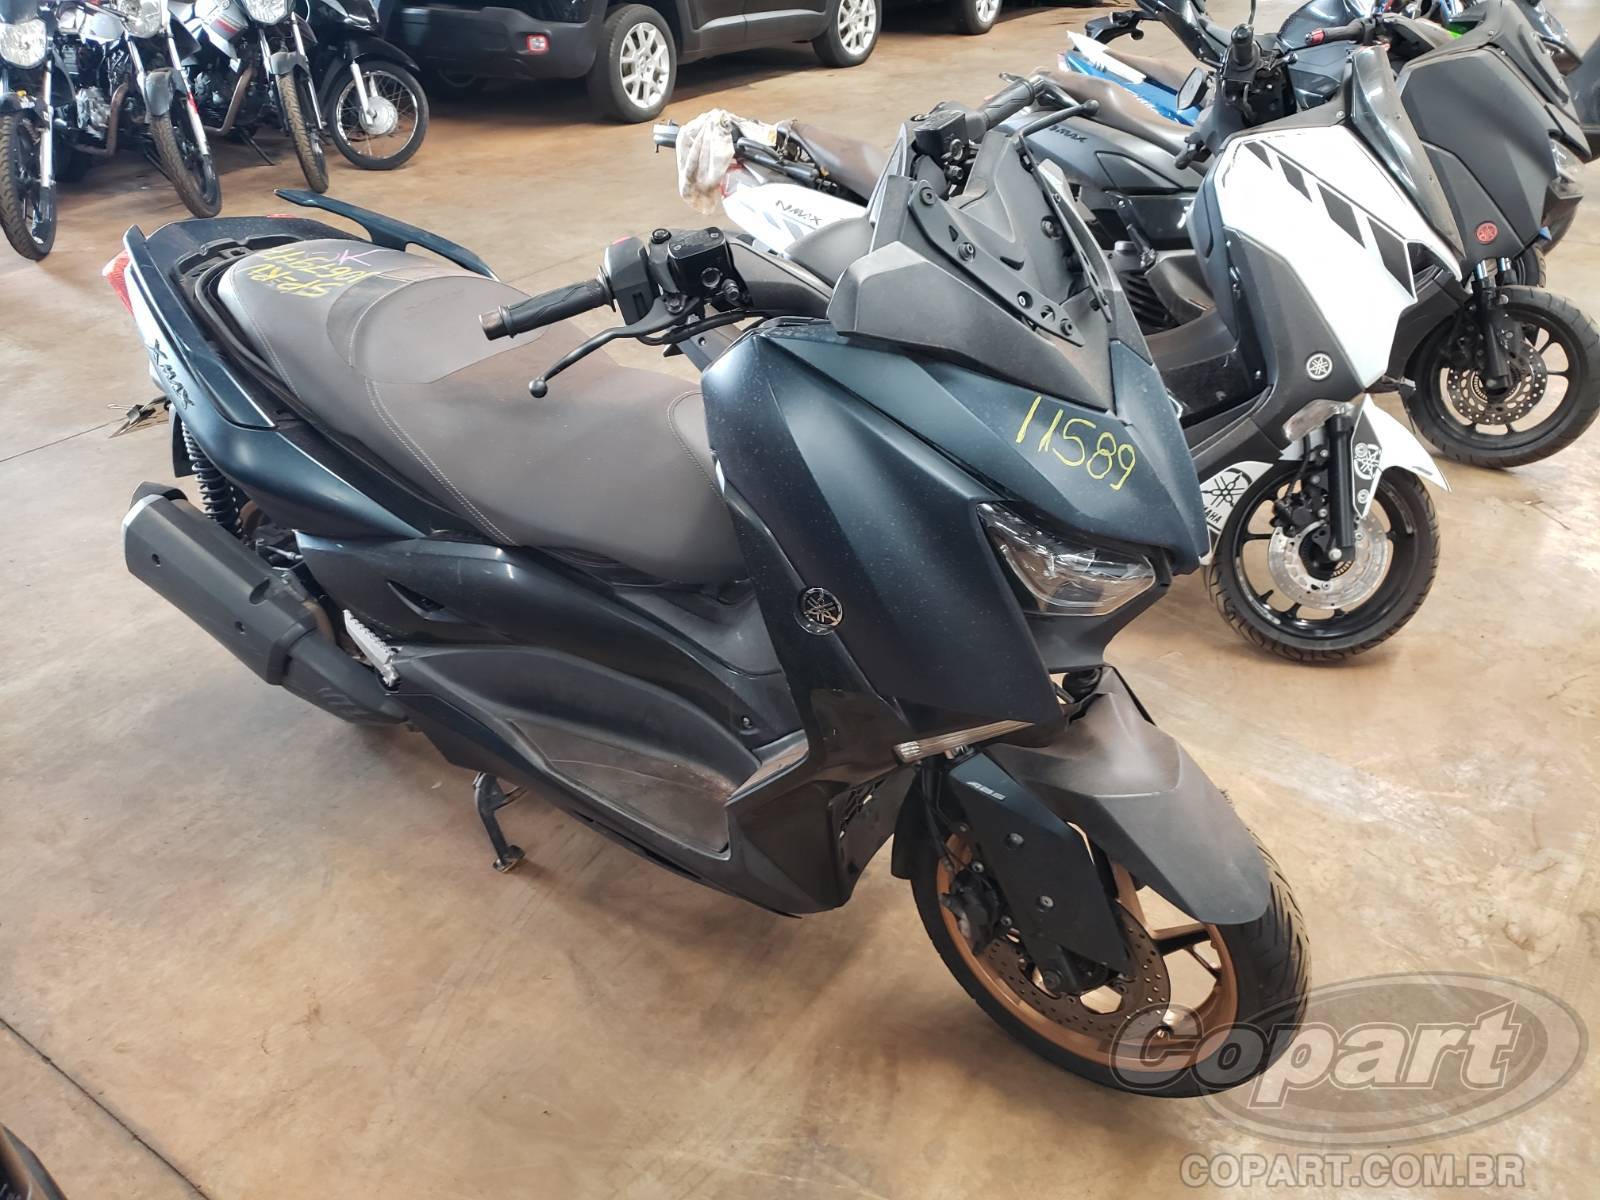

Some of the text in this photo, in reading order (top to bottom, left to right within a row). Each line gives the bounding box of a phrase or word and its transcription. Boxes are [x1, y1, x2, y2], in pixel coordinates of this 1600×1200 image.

[775, 199, 823, 226] NMAX
[147, 338, 195, 411] XMAX
[1015, 395, 1136, 491] 11589
